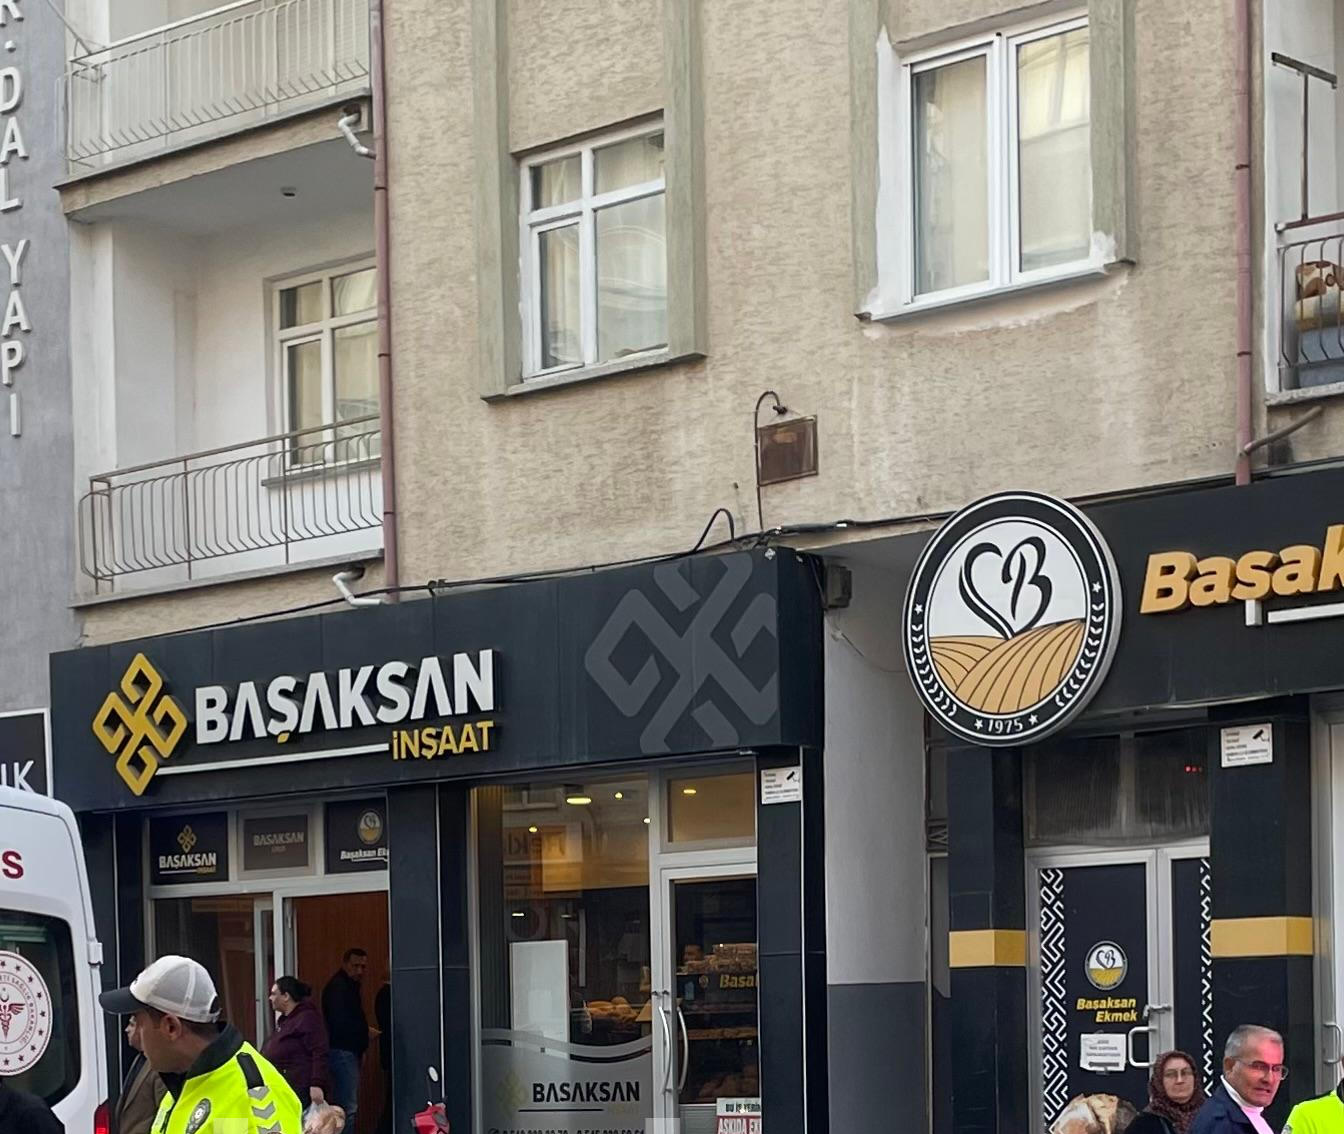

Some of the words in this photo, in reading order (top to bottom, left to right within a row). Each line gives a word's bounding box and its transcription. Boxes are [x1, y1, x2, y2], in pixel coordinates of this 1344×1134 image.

[0, 239, 31, 438] YAPI
[195, 649, 494, 744] BAŞAKSAN
[392, 720, 494, 760] İNŞAAT
[988, 718, 1023, 734] 1975
[1096, 1009, 1137, 1022] Ekmek
